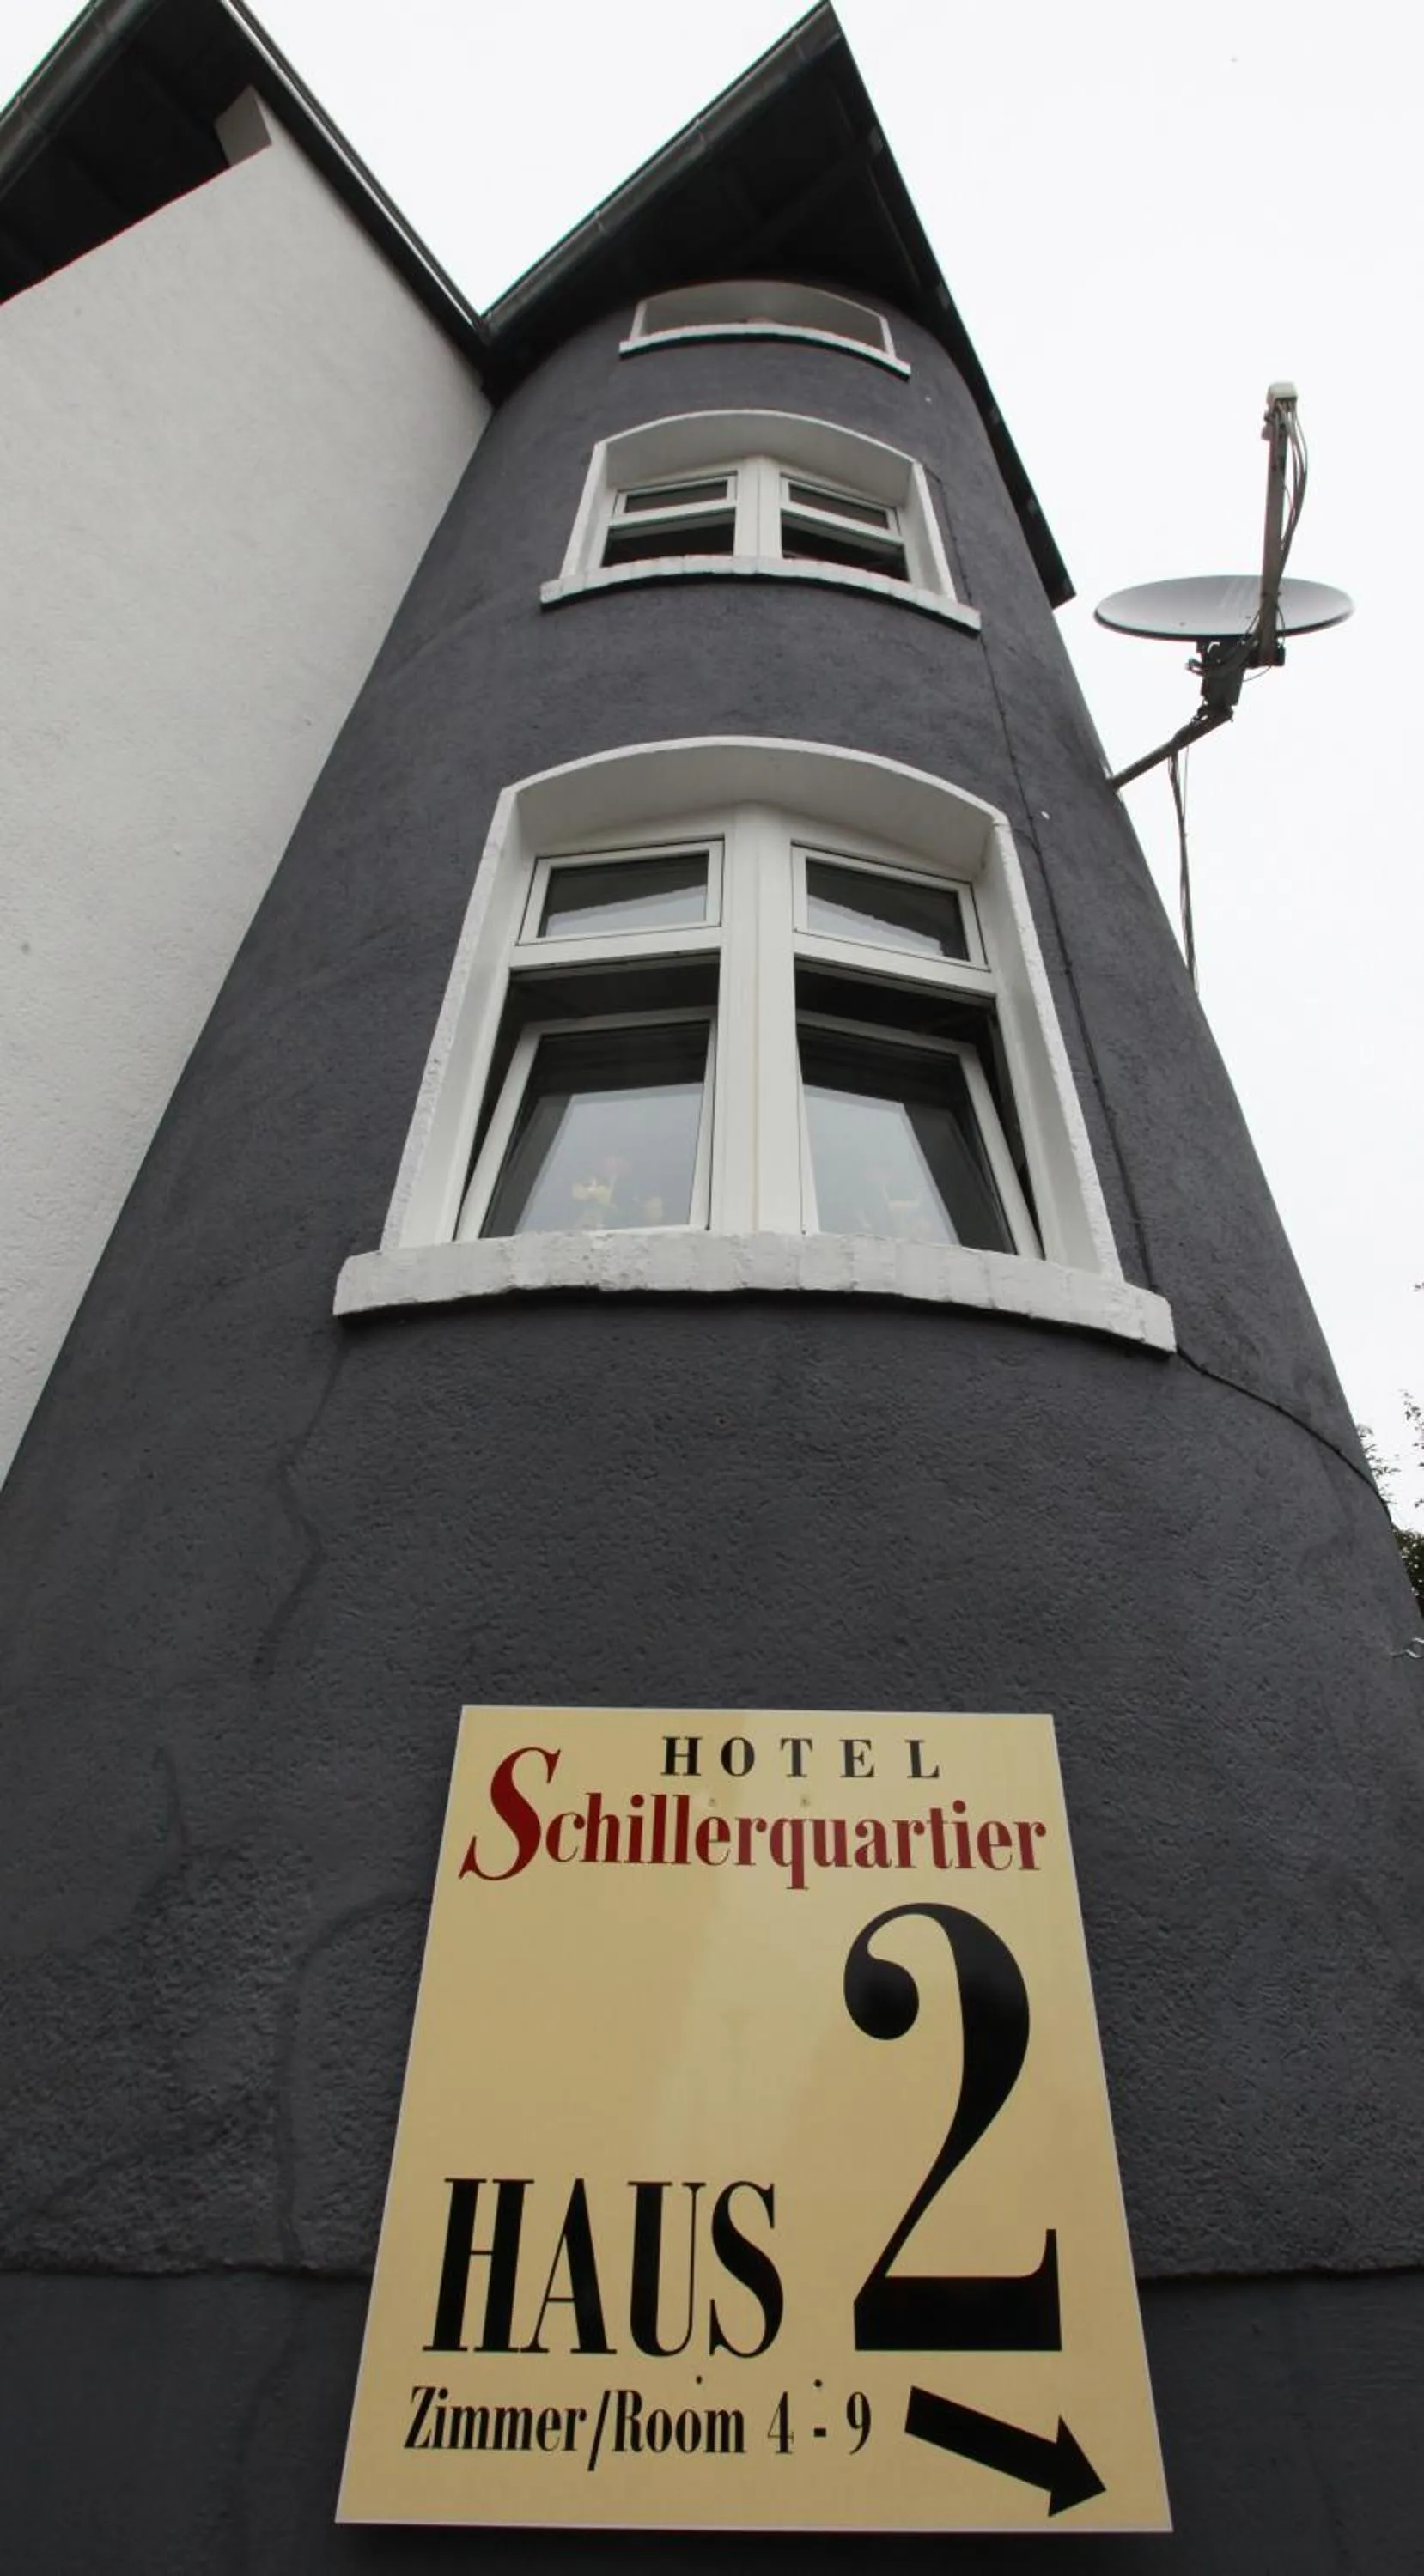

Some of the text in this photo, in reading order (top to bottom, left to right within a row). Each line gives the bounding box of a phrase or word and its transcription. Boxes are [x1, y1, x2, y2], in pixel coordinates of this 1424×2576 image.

[660, 1735, 940, 1780] HOTEL
[458, 1747, 1047, 1890] Schillerquartier
[421, 1902, 1063, 2360] HAUS 2
[403, 2385, 747, 2472] Zimmer/Room
[766, 2390, 794, 2455] 4
[845, 2391, 873, 2456] 9
